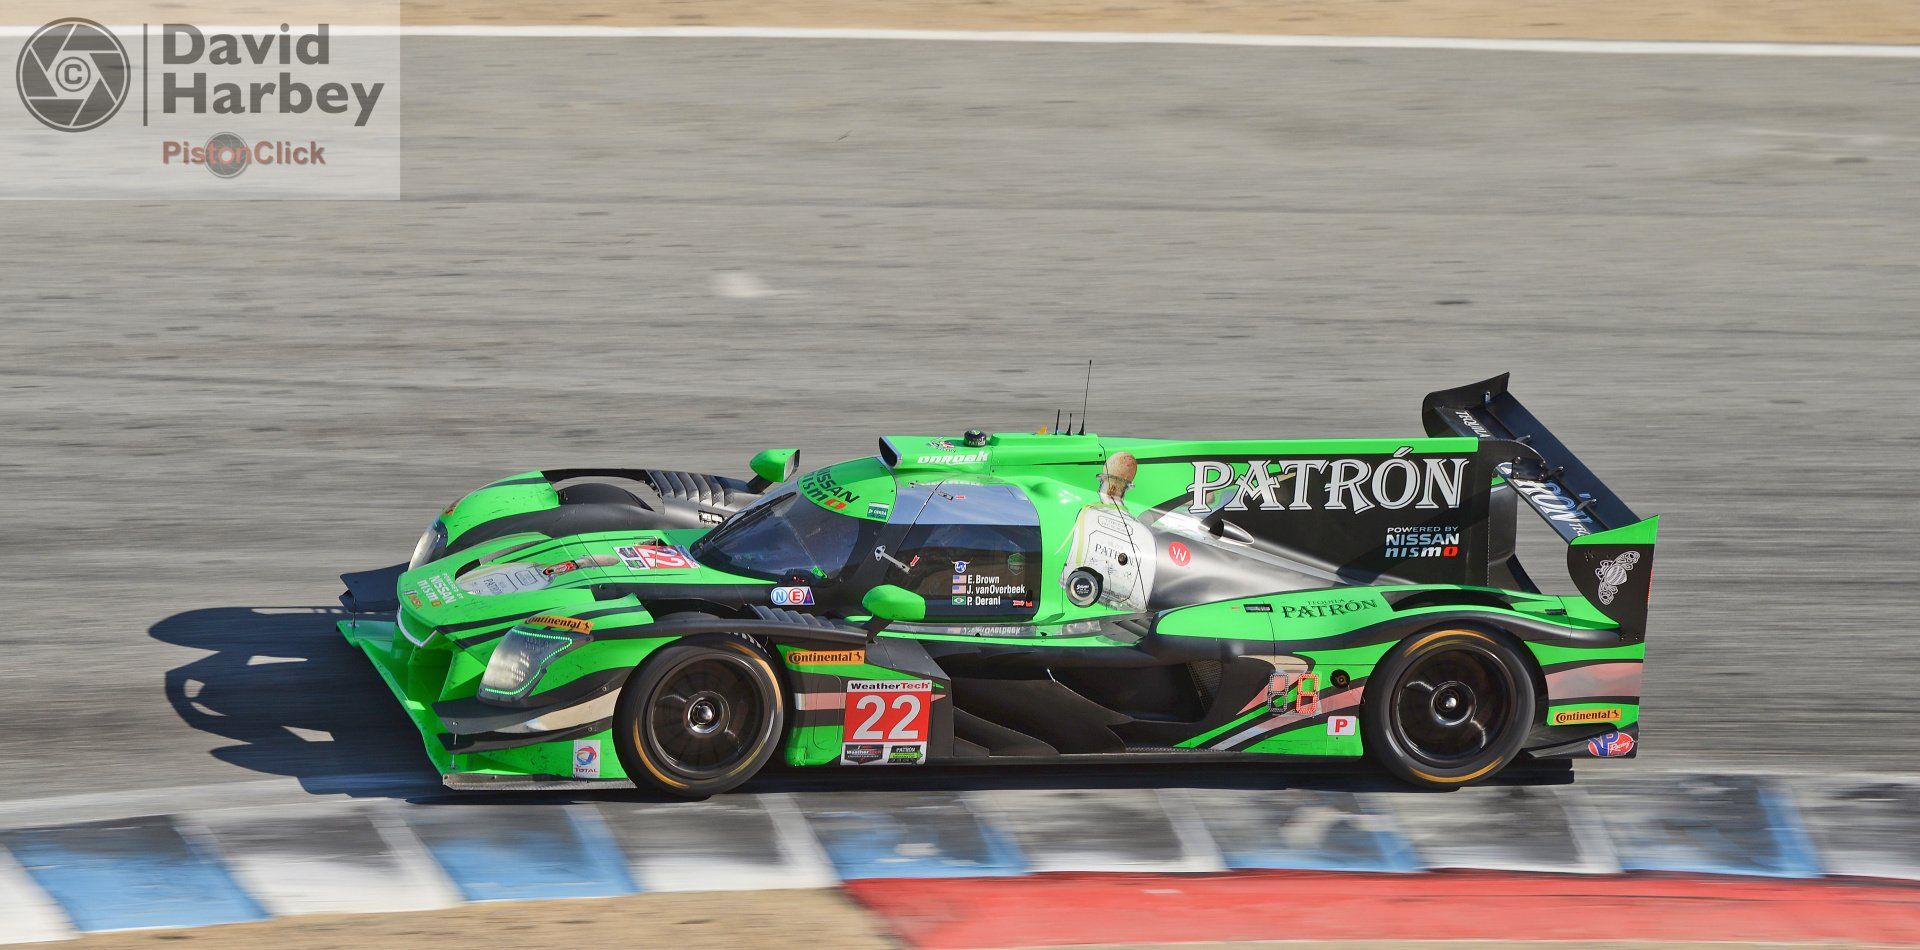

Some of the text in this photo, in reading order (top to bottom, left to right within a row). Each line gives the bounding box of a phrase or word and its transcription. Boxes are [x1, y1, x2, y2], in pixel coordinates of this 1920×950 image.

[1187, 446, 1470, 515] PATRÓN
[1387, 526, 1441, 534] POWERED
[1385, 533, 1460, 546] NISSAN
[1384, 546, 1459, 558] nismo
[967, 574, 1000, 584] E. Brown
[967, 585, 974, 594] J.
[967, 597, 973, 606] P.
[524, 616, 582, 630] Continental
[788, 652, 852, 664] Continental
[851, 682, 930, 690] WeatherTech
[853, 694, 921, 740] 22
[1555, 710, 1611, 724] Continental
[1334, 718, 1349, 734] P
